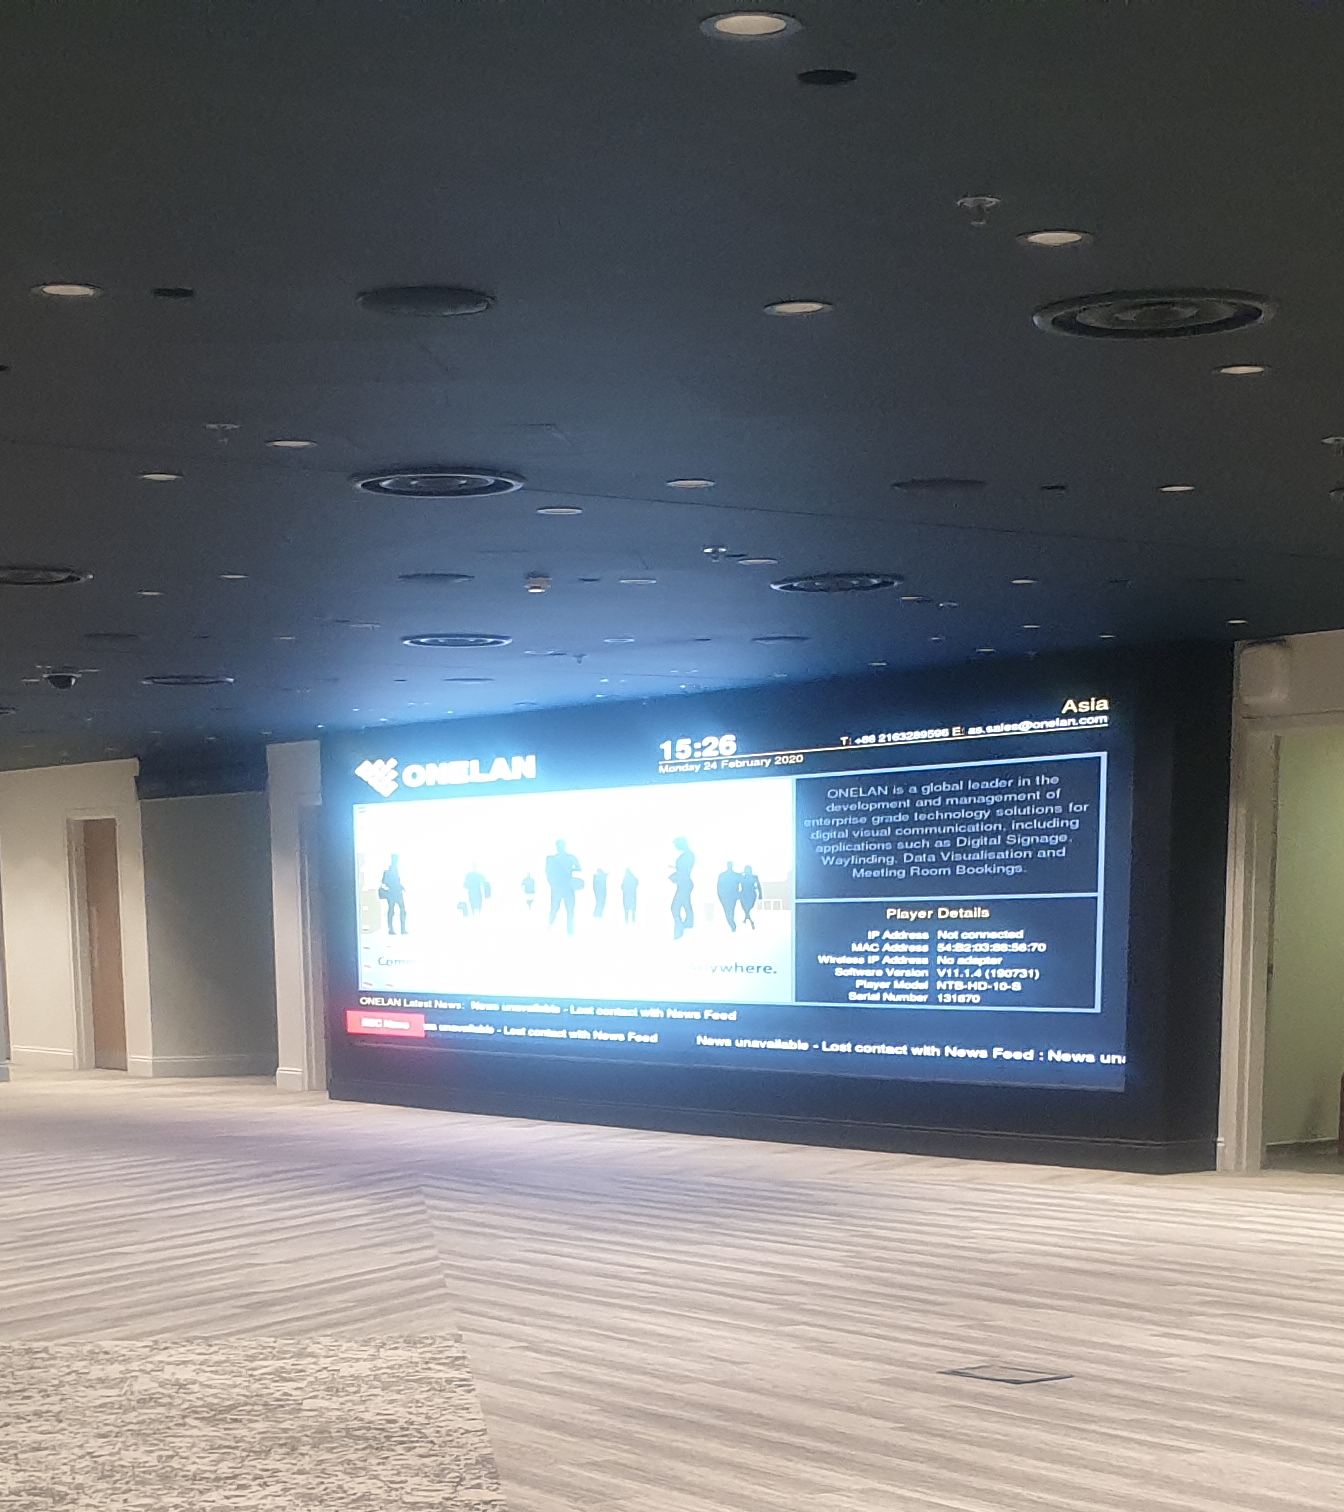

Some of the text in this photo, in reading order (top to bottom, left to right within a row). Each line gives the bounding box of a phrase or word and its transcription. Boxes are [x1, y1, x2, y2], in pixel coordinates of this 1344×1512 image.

[1061, 697, 1109, 714] Asia
[659, 734, 737, 760] 15:26
[402, 755, 536, 788] ONELAN
[659, 754, 804, 774] Monday 24 February 2020
[827, 774, 1059, 798] ONELAN is a global leader in the
[826, 788, 1061, 812] development and management of
[803, 802, 1089, 827] enterprise grade technology solutions for
[810, 829, 848, 841] digital
[852, 827, 891, 838] visual
[1011, 818, 1079, 830] including
[816, 841, 892, 854] applications
[897, 839, 929, 850] such
[934, 839, 951, 848] as
[956, 835, 1001, 849] Digital
[903, 852, 936, 863] Data
[941, 848, 1033, 861] Visualisation
[1037, 847, 1066, 858] and
[852, 863, 1027, 879] Meeting Room Bookings.
[886, 906, 990, 921] Player Details
[867, 930, 1024, 940] IP Address Not connected
[851, 943, 880, 952] MAC
[881, 942, 929, 952] Address
[689, 961, 778, 975] ywhere.
[817, 954, 1003, 967] Wireless IP Address No adapter
[835, 967, 883, 977] Software
[885, 967, 929, 977] Version
[936, 968, 982, 978] V11.1.4
[856, 980, 891, 990] Player
[893, 980, 929, 989] Model
[848, 992, 881, 1001] Serial
[883, 992, 928, 1002] Number
[359, 997, 401, 1007] ONELAN
[403, 999, 432, 1008] Latest
[434, 1000, 465, 1009] News:
[569, 1005, 594, 1015] Lost
[596, 1006, 638, 1017] contact
[640, 1008, 664, 1018] with
[666, 1008, 701, 1019] News
[704, 1009, 737, 1021] Feed
[503, 1025, 526, 1036] Lost
[528, 1027, 567, 1038] contact
[568, 1029, 591, 1040] with
[592, 1030, 625, 1041] News
[627, 1031, 659, 1043] Feed
[696, 1034, 732, 1046] News
[735, 1037, 809, 1050] unavailable
[822, 1041, 852, 1052] Lost
[854, 1043, 907, 1055] contact
[911, 1044, 941, 1057] with
[944, 1046, 988, 1059] News
[992, 1047, 1034, 1061] Feed
[1047, 1049, 1095, 1063] News
